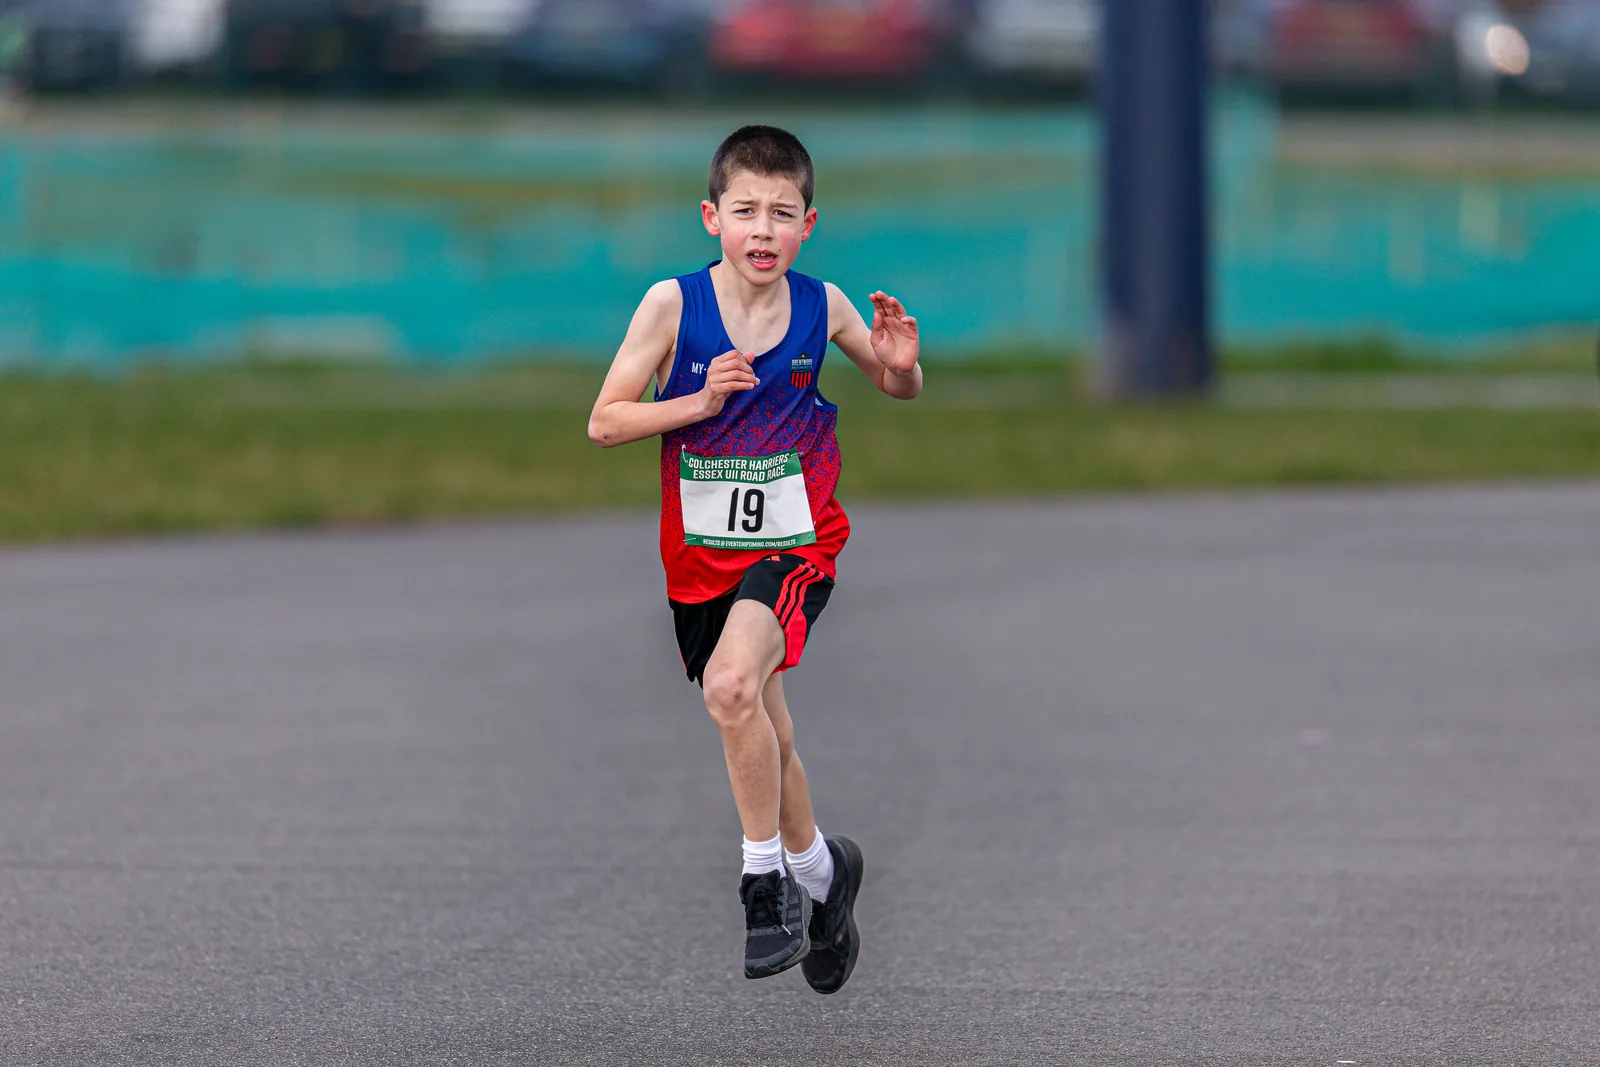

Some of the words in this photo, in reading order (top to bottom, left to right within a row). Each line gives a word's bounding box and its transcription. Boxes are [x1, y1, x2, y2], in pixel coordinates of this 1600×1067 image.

[691, 362, 709, 375] MY-
[688, 457, 747, 470] COLCHESTER
[749, 453, 789, 470] HARRIERS
[693, 470, 723, 479] ESSEX
[740, 471, 765, 482] ROAD
[766, 464, 785, 480] RACE
[727, 487, 765, 533] 19
[703, 538, 720, 546] RESULTS
